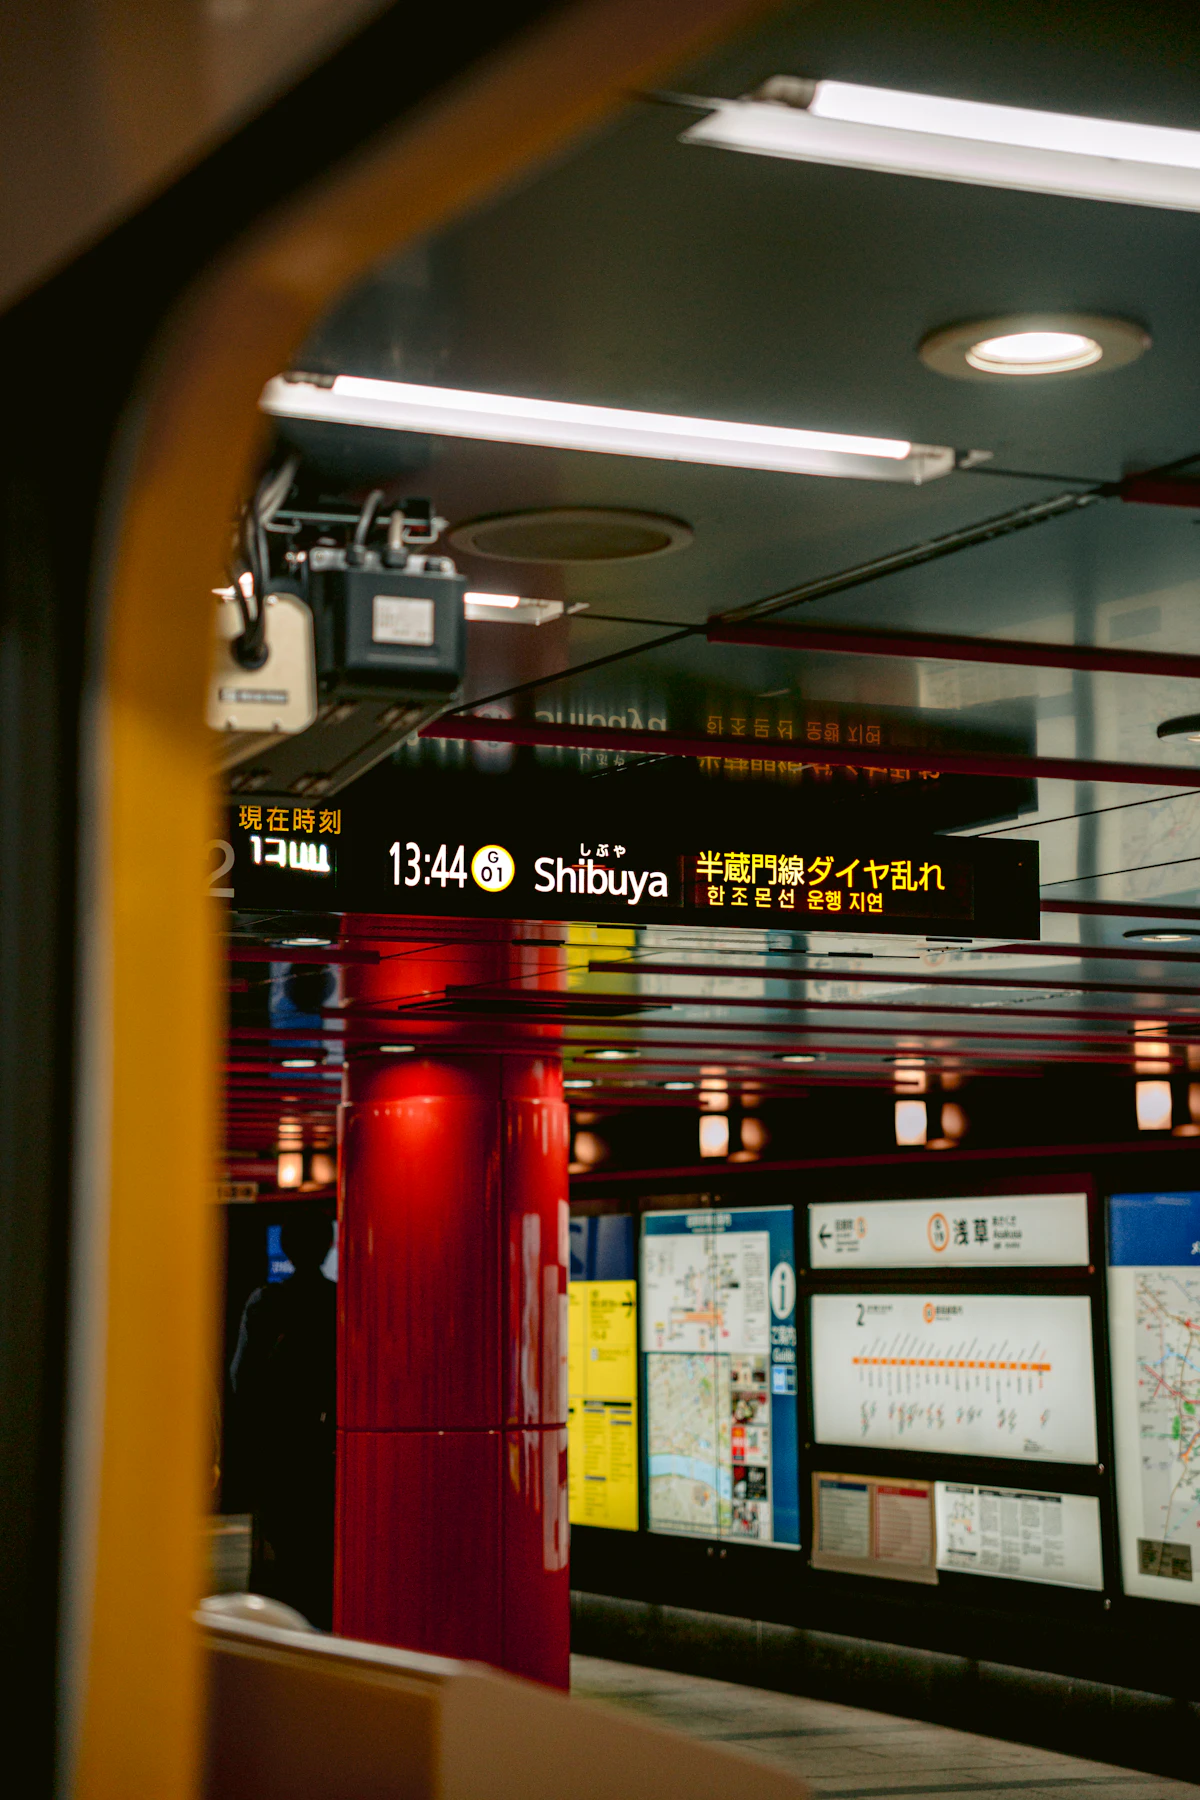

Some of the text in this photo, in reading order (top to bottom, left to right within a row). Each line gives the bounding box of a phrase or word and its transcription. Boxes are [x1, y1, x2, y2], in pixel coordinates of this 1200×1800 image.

[238, 805, 342, 835] 現在時刻
[488, 850, 499, 864] G
[580, 843, 626, 858] しぶや
[206, 838, 235, 898] 2
[389, 842, 467, 888] 13:44
[481, 867, 502, 882] 01
[696, 850, 945, 893] 半蔵門線ダイヤ乱れ
[534, 857, 668, 905] Shibuya
[807, 890, 842, 912] 운행
[849, 892, 883, 913] 지연
[953, 1218, 989, 1245] 浅草
[856, 1303, 865, 1326] 2
